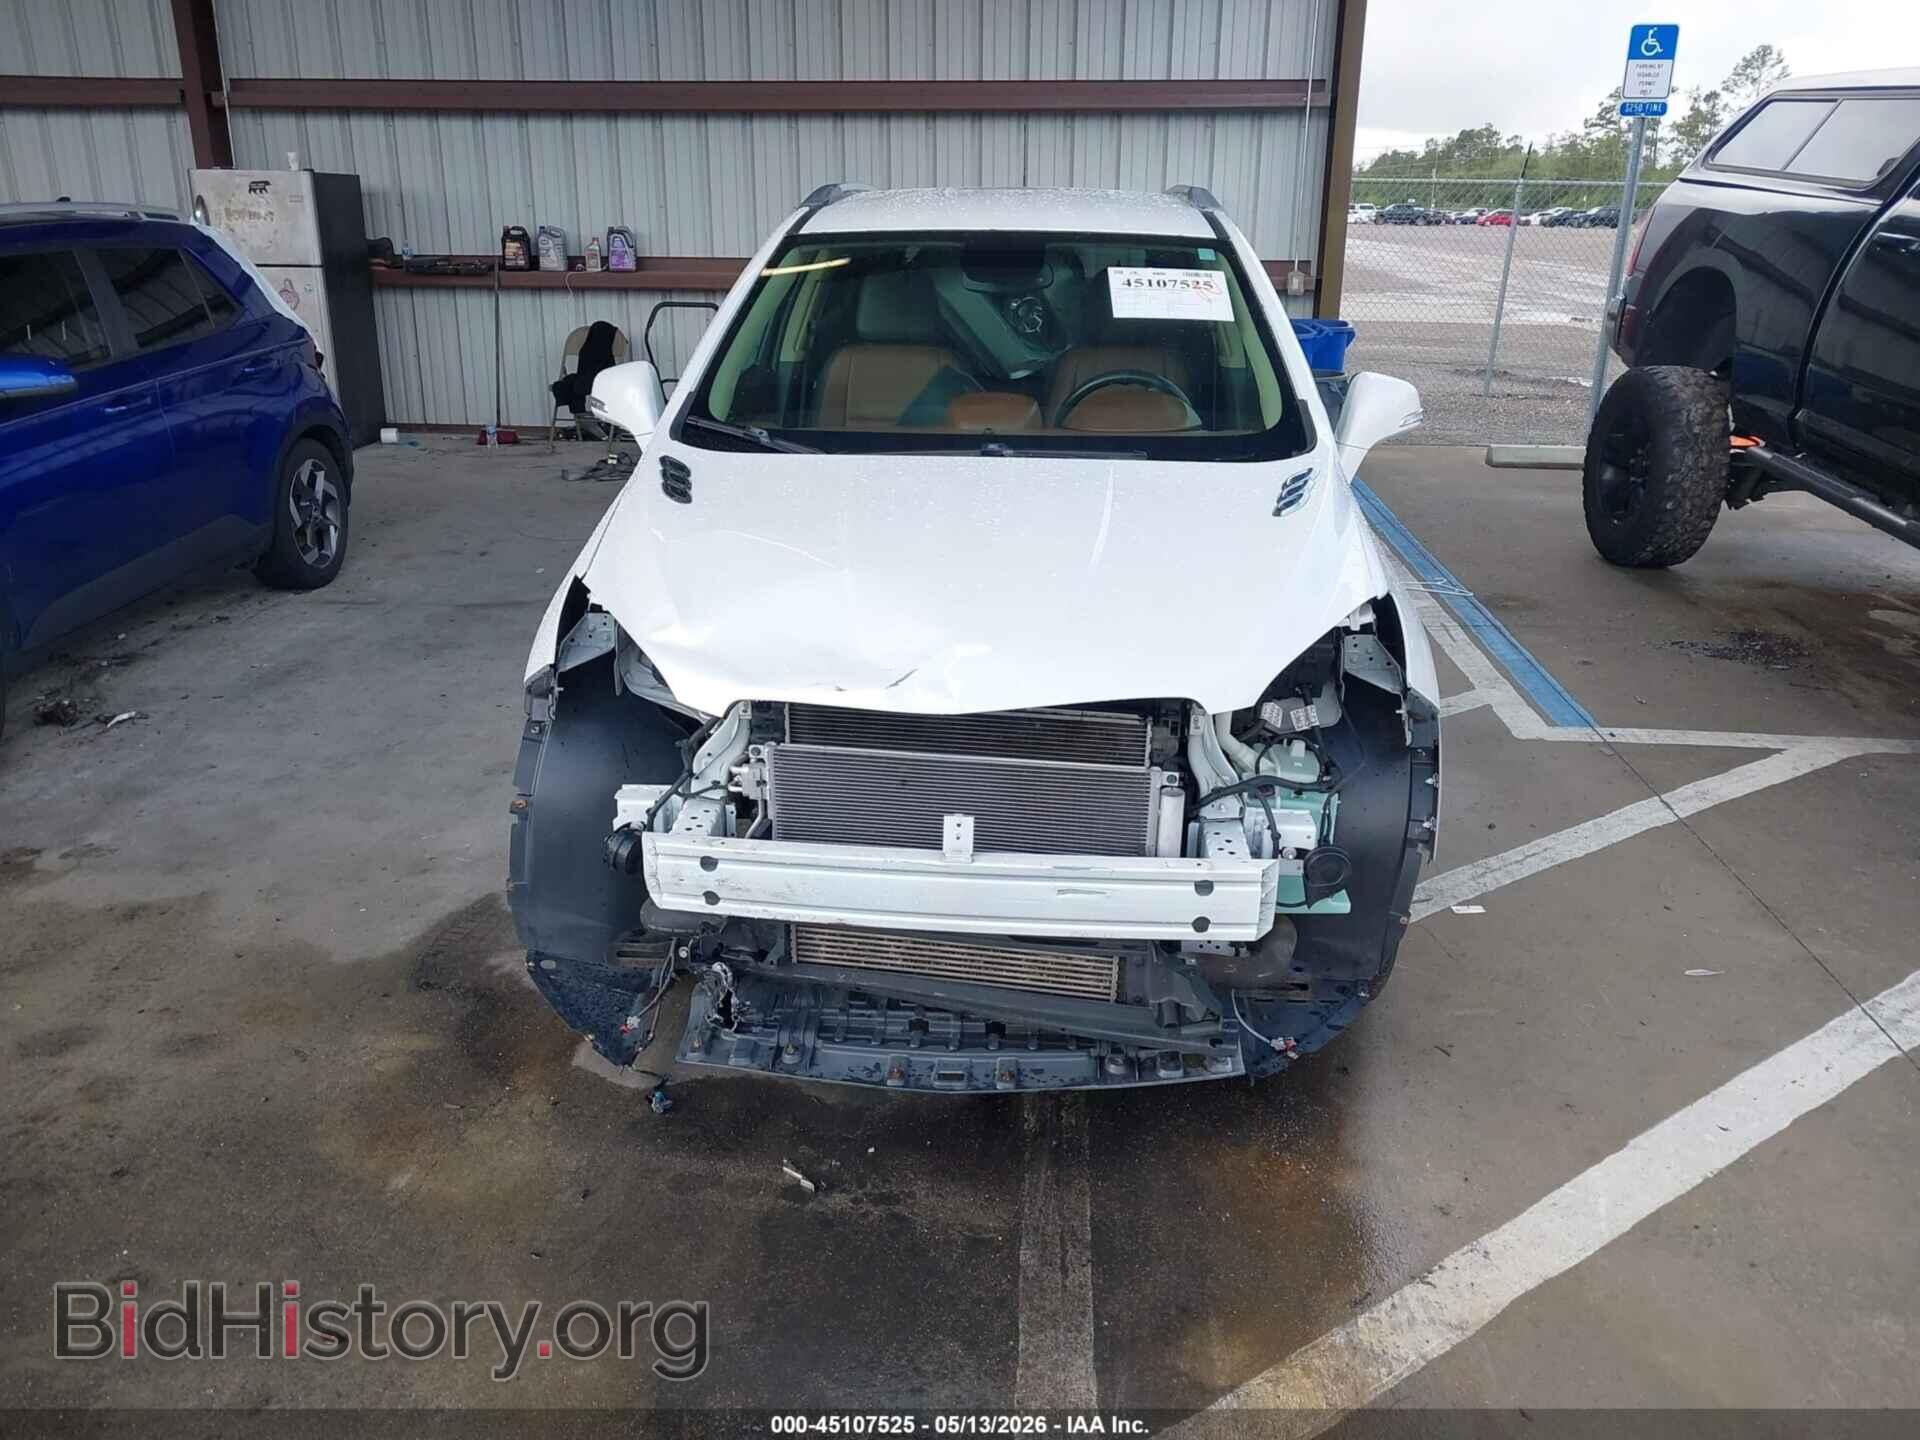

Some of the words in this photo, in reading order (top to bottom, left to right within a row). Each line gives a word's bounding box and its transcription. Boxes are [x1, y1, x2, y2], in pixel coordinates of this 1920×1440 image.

[1625, 103, 1643, 113] $250
[1645, 103, 1663, 113] FINE
[1121, 278, 1214, 290] 45107525
